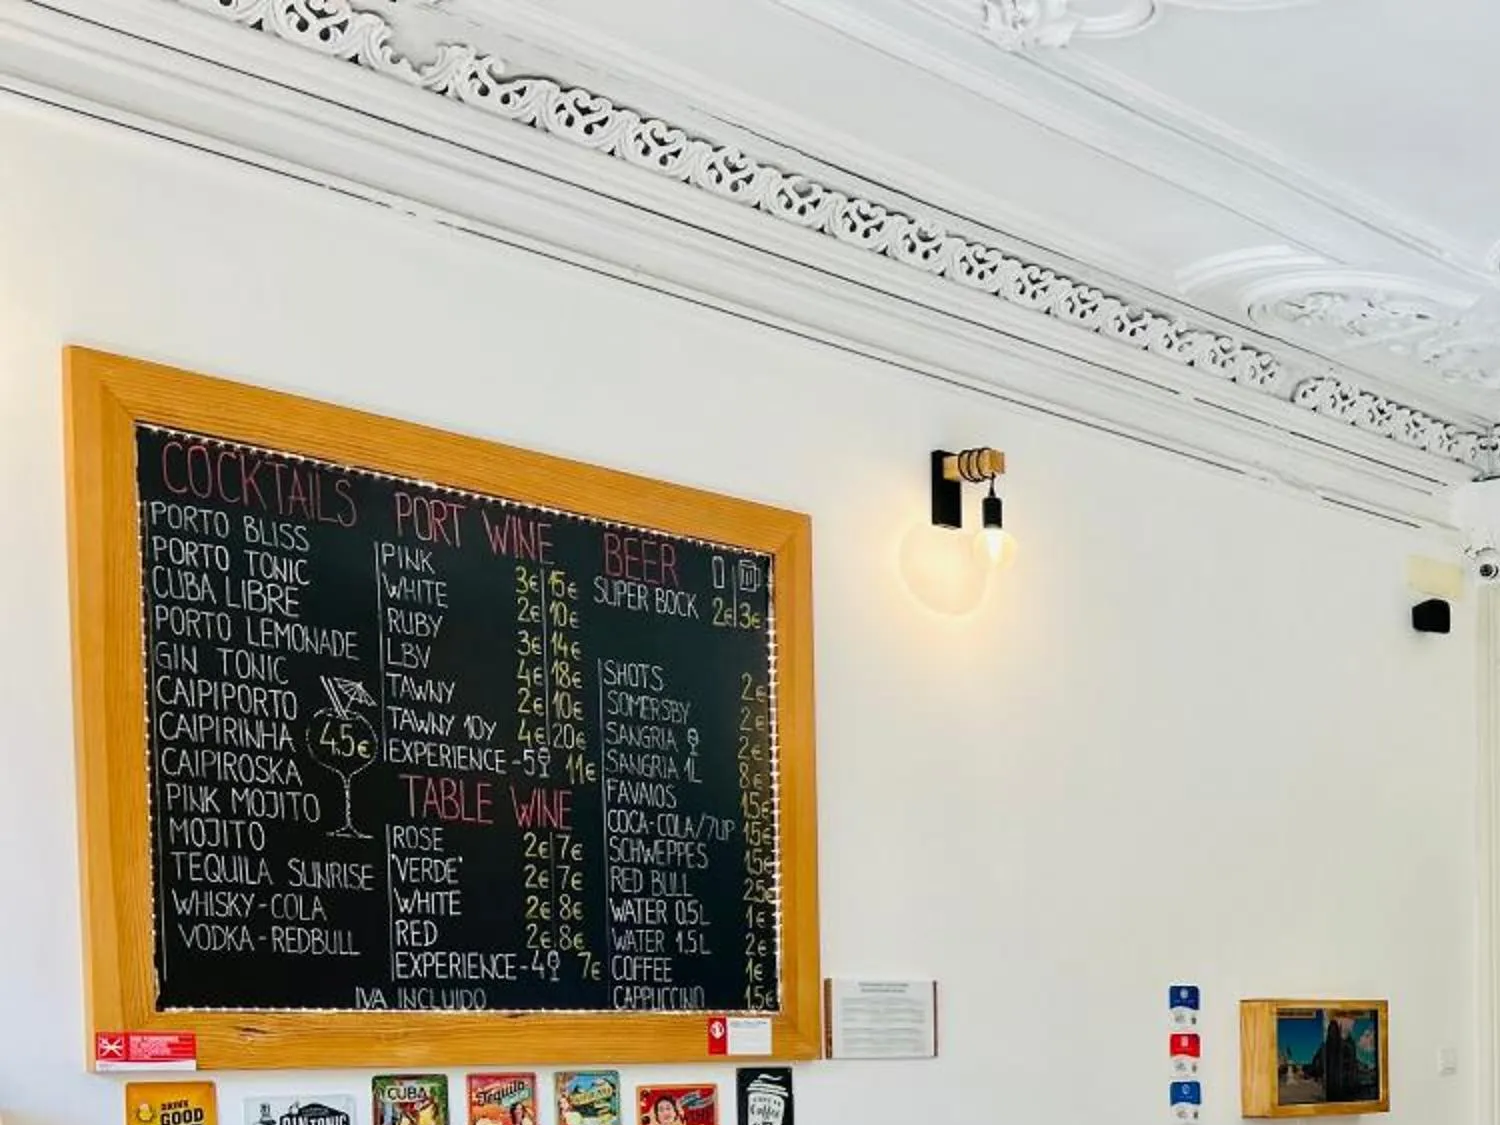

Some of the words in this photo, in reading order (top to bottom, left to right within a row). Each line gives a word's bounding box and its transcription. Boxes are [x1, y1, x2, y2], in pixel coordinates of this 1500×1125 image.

[162, 441, 358, 528] COCKTAILS
[151, 500, 230, 539] PORTO
[243, 514, 311, 554] BLISS
[394, 491, 467, 548] PORT
[481, 510, 555, 566] WINE
[152, 535, 230, 572] PORTO
[243, 548, 311, 587] TONIC
[381, 542, 436, 575] PINK
[603, 532, 680, 586] BEER
[152, 565, 217, 604] CUBA
[225, 574, 301, 618] LIBRE
[381, 572, 449, 609] WHITE
[593, 575, 649, 613] SUPER
[655, 587, 700, 620] BOCK
[155, 605, 232, 642] PORTO
[246, 614, 360, 663] LEMONADE
[387, 606, 444, 639] RUBY
[156, 641, 198, 675] GIN
[217, 646, 290, 686] TONIC
[387, 637, 431, 670] LBV
[385, 671, 456, 704] TAWNY
[603, 658, 665, 693] SHOTS
[156, 675, 298, 720] CAIPIPORTO
[606, 690, 692, 726] SOMERSBY
[158, 710, 298, 754] CAIPIRINHA
[385, 705, 456, 737] TAWNY
[463, 714, 498, 742] 10Y
[605, 720, 679, 753] SANGRIA
[161, 747, 304, 788] CAIPIROSKA
[605, 747, 680, 780] SANGRIA
[165, 782, 221, 815] PINK
[230, 787, 322, 824] MOJITO
[399, 773, 495, 826] TABLE
[509, 784, 574, 832] WINE
[606, 777, 678, 809] FAVAIOS
[168, 818, 266, 851] MOJITO
[393, 825, 445, 853] ROSE
[609, 835, 710, 870] SCHWEPPES
[170, 850, 274, 887] TEQUILA
[287, 857, 375, 891] SUNRISE
[610, 866, 644, 894] RED
[651, 869, 694, 898] BULL
[393, 887, 462, 916] WHITE
[609, 897, 668, 926] WATER
[395, 918, 439, 948] RED
[612, 927, 665, 954] WATER
[611, 955, 673, 983] COFFEE
[355, 985, 388, 1010] IVA
[399, 986, 488, 1010] INCLUIDO
[613, 985, 706, 1010] CAPPUCCINO
